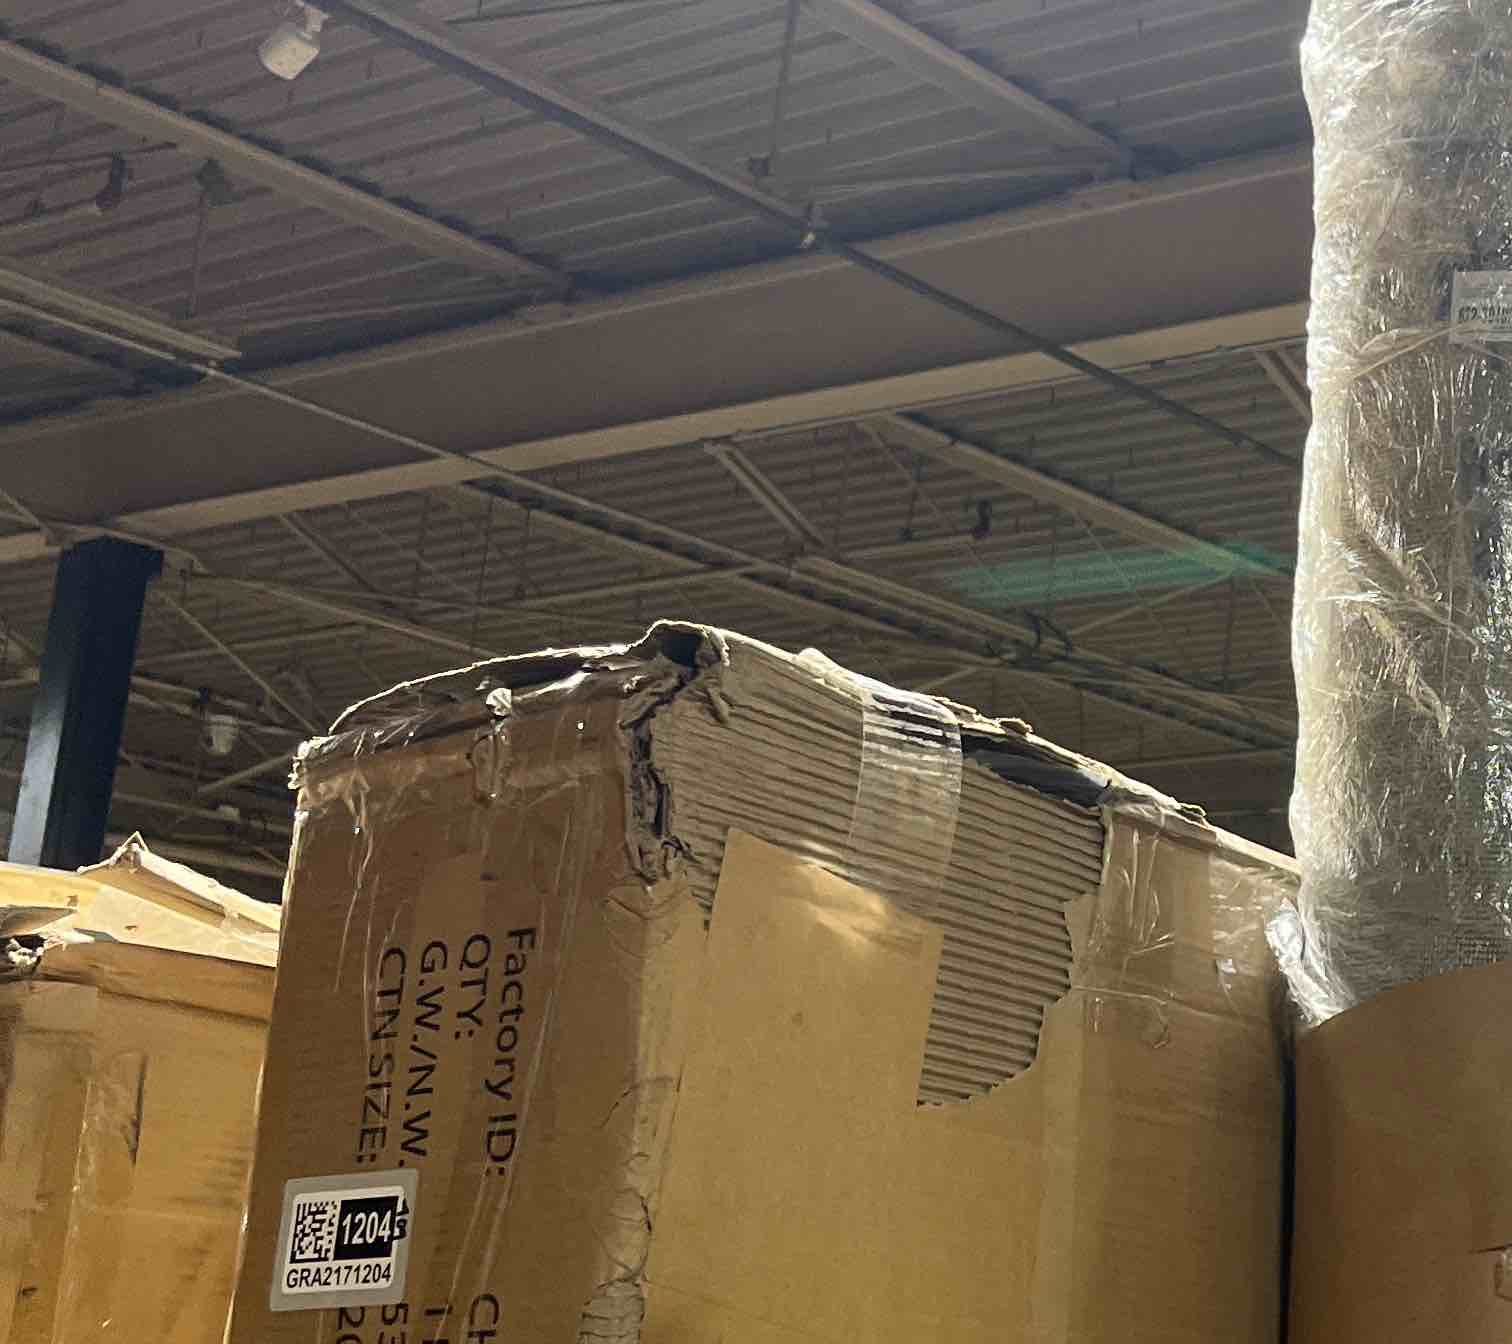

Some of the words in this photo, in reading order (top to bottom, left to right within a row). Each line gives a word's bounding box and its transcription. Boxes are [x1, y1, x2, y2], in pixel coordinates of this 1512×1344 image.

[370, 947, 407, 1041] CTN
[454, 933, 491, 1040] QTY:
[484, 927, 536, 1101] Factory
[356, 1053, 394, 1163] SIZE:
[485, 1112, 517, 1177] ID:
[286, 1262, 392, 1288] GRA2171204
[342, 1210, 391, 1246] 1204
